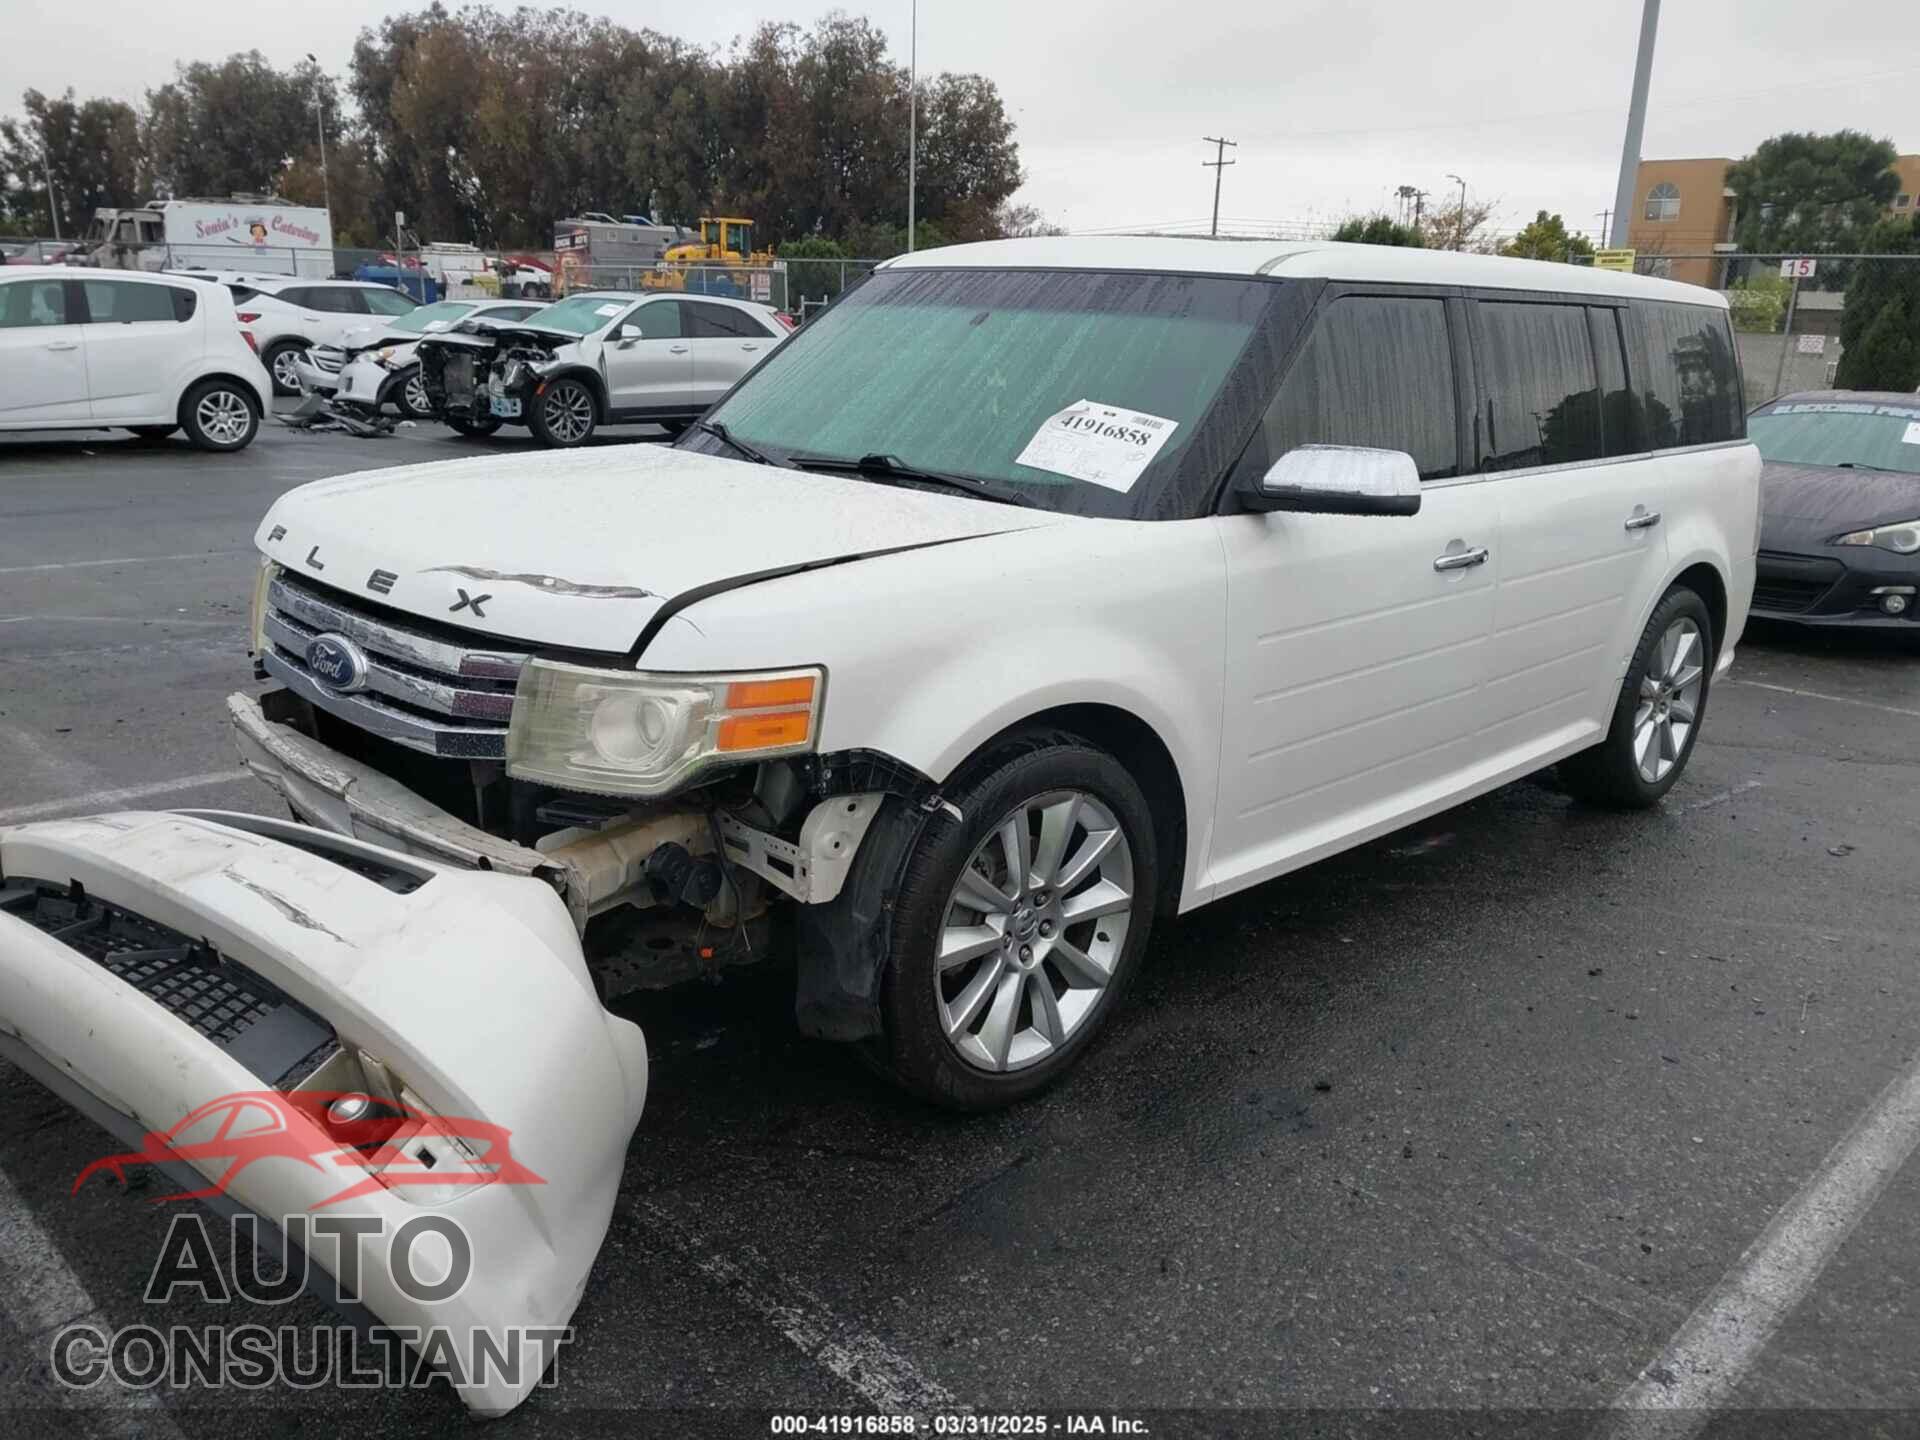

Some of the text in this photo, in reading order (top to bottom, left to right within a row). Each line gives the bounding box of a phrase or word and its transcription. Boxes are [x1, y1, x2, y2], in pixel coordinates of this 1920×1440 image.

[271, 215, 320, 246] Catering
[1787, 260, 1809, 276] 15
[1061, 415, 1152, 446] 41916858
[267, 524, 493, 618] FLEX
[312, 643, 343, 678] Ford
